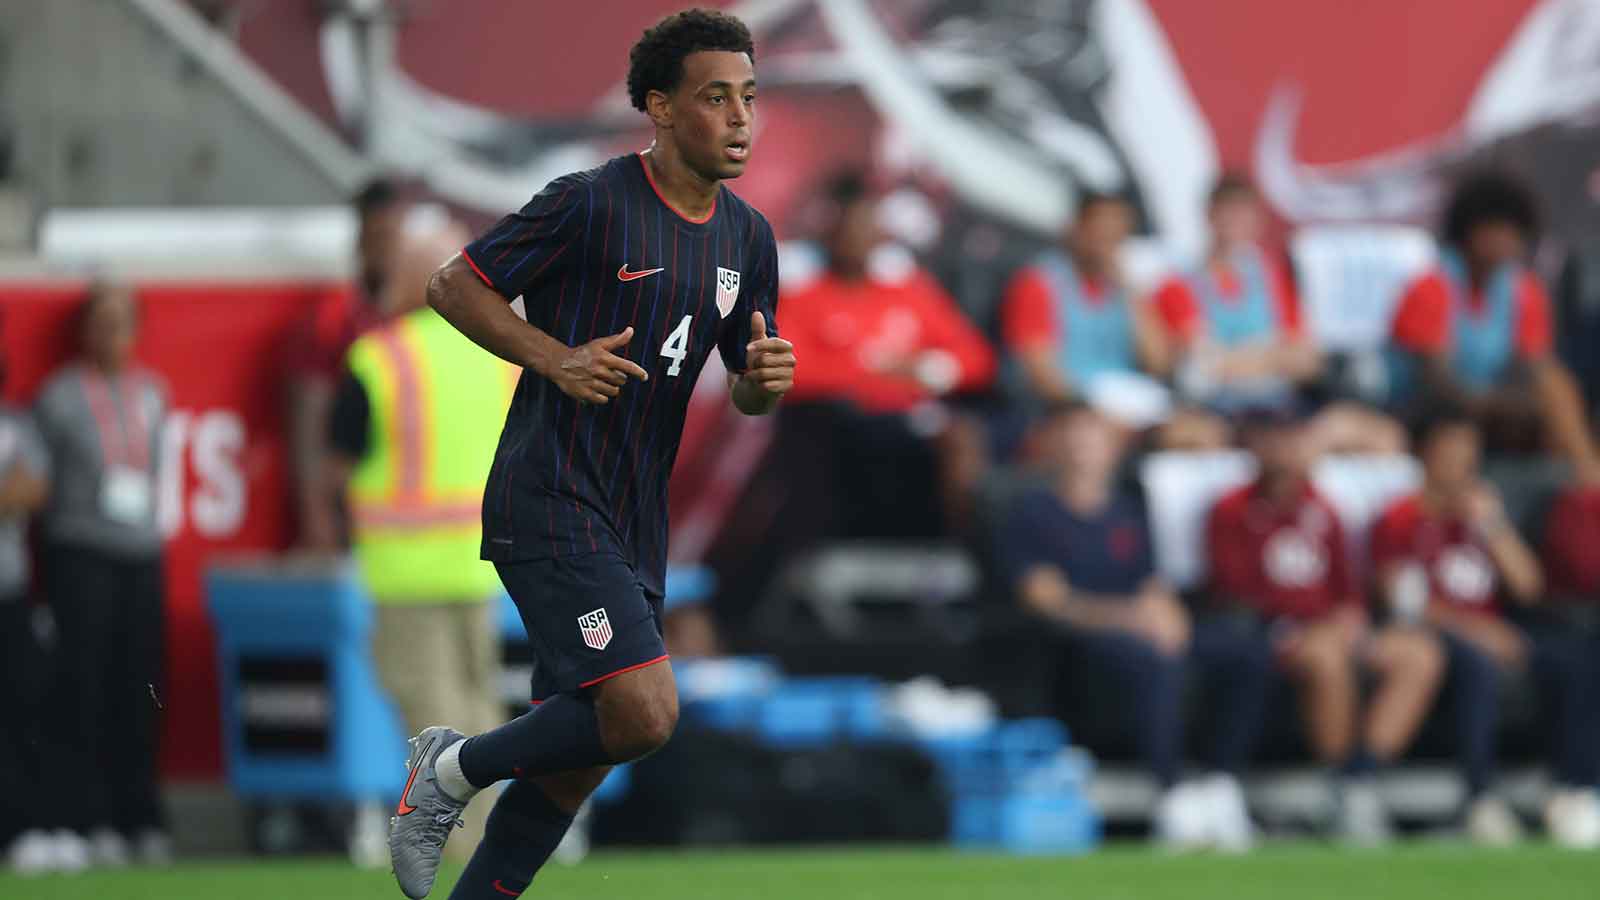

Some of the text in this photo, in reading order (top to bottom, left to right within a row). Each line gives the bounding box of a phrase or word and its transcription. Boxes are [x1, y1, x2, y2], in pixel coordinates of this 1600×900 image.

[718, 269, 739, 291] USA
[660, 315, 692, 376] 4
[579, 610, 606, 629] USA
